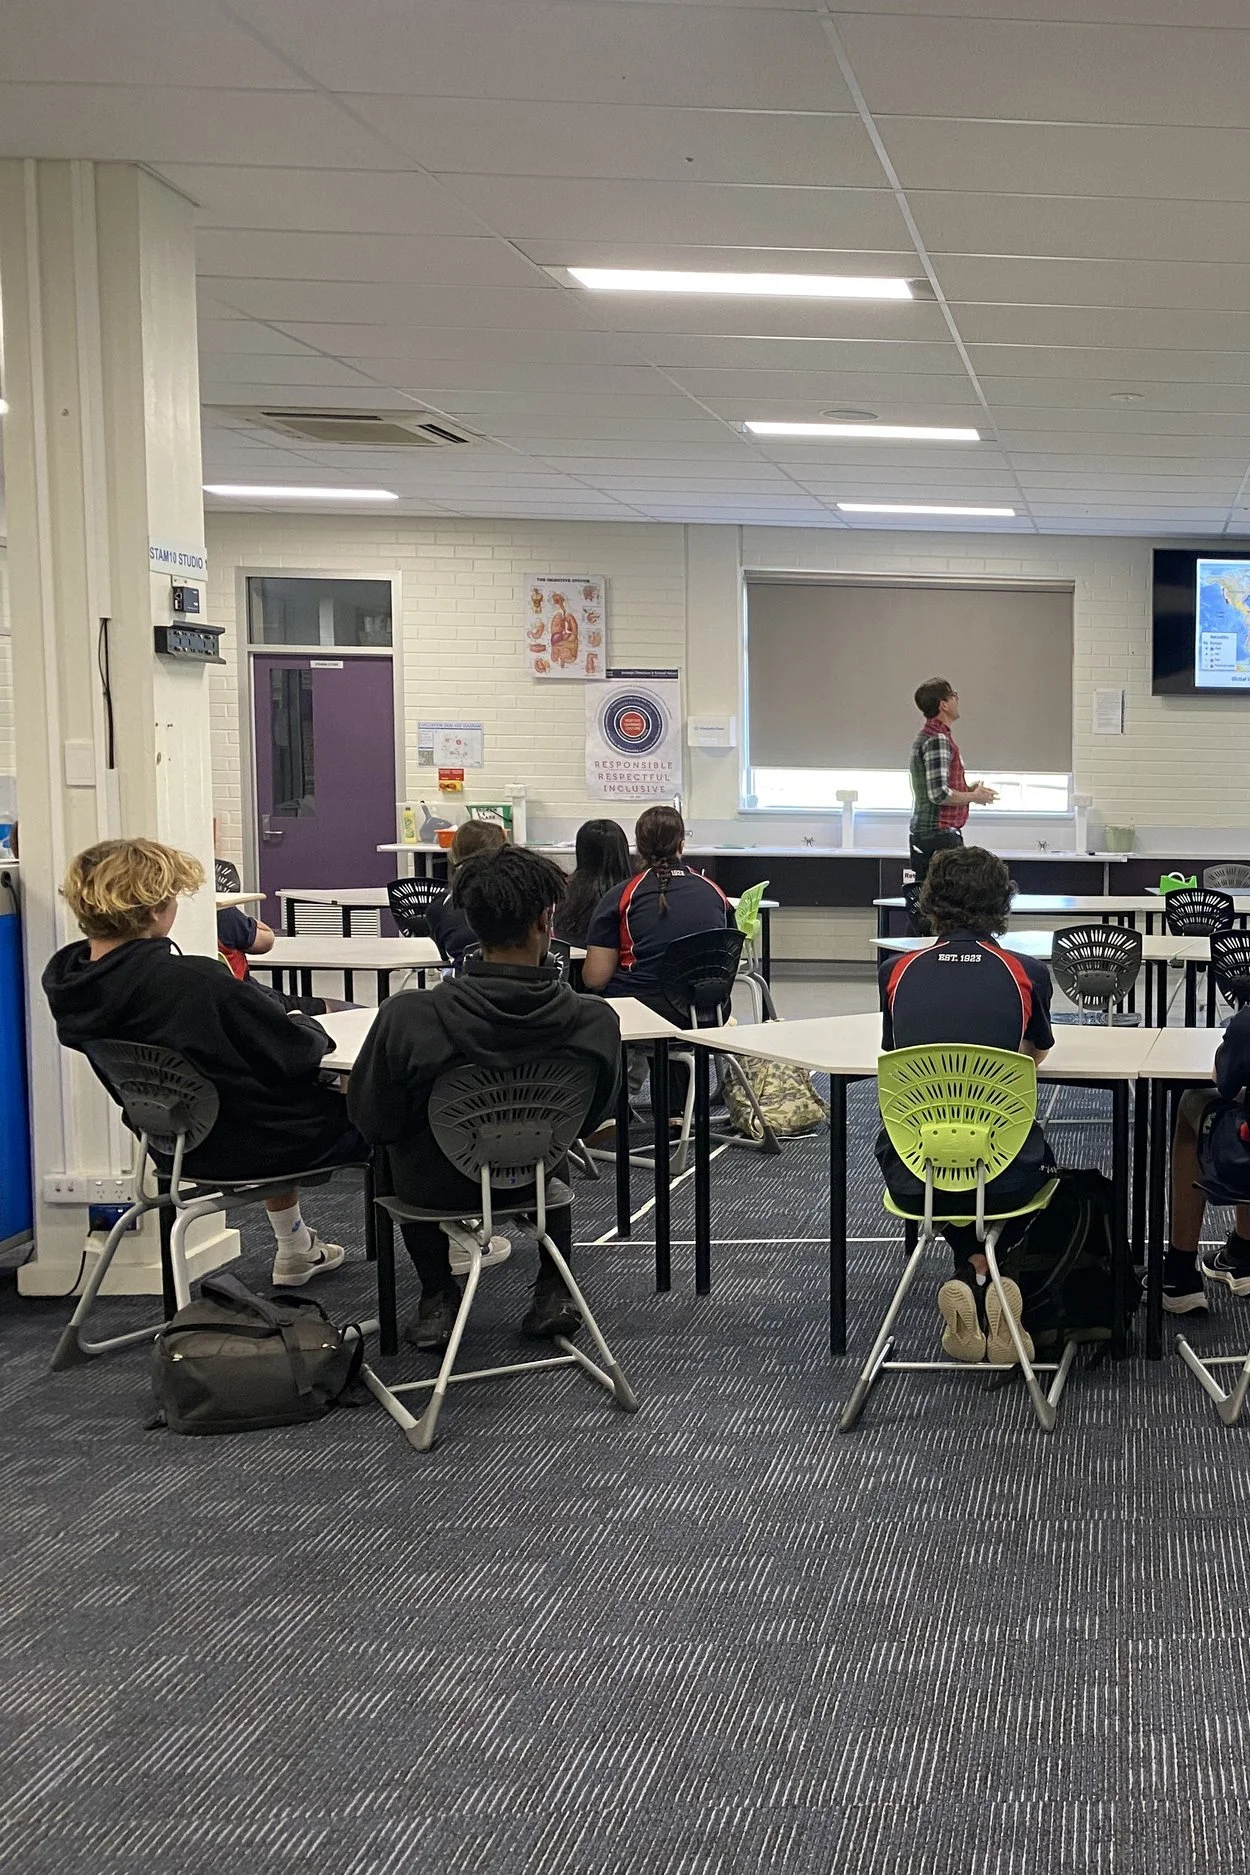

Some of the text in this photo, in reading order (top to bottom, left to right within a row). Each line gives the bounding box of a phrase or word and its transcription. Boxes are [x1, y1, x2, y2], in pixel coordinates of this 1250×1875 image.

[149, 546, 177, 564] STAM10
[178, 552, 203, 570] STUDIO
[594, 761, 673, 769] RESPONSIBLE
[598, 773, 670, 781] RESPECTFUL
[604, 785, 666, 793] INCLUSIVE
[938, 953, 982, 962] EST. 1923
